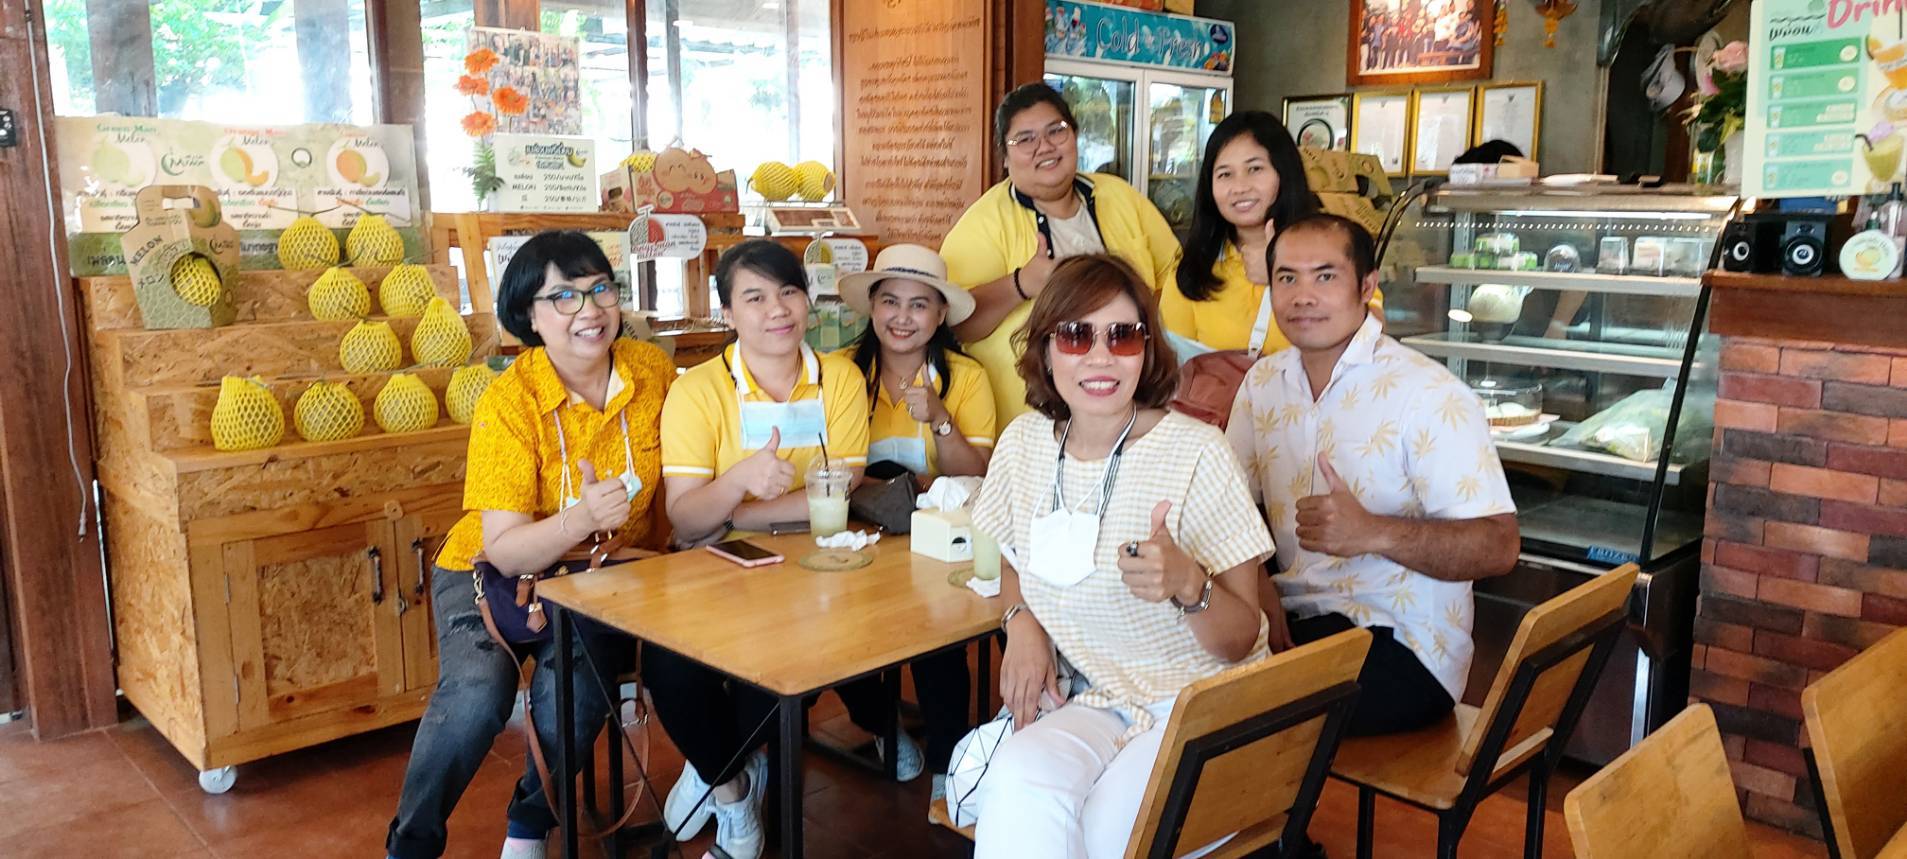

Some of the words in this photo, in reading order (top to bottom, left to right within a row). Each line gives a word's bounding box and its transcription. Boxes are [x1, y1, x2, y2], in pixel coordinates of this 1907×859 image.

[1827, 0, 1907, 29] Drin
[1097, 15, 1141, 53] Cold
[130, 235, 163, 266] MELON
